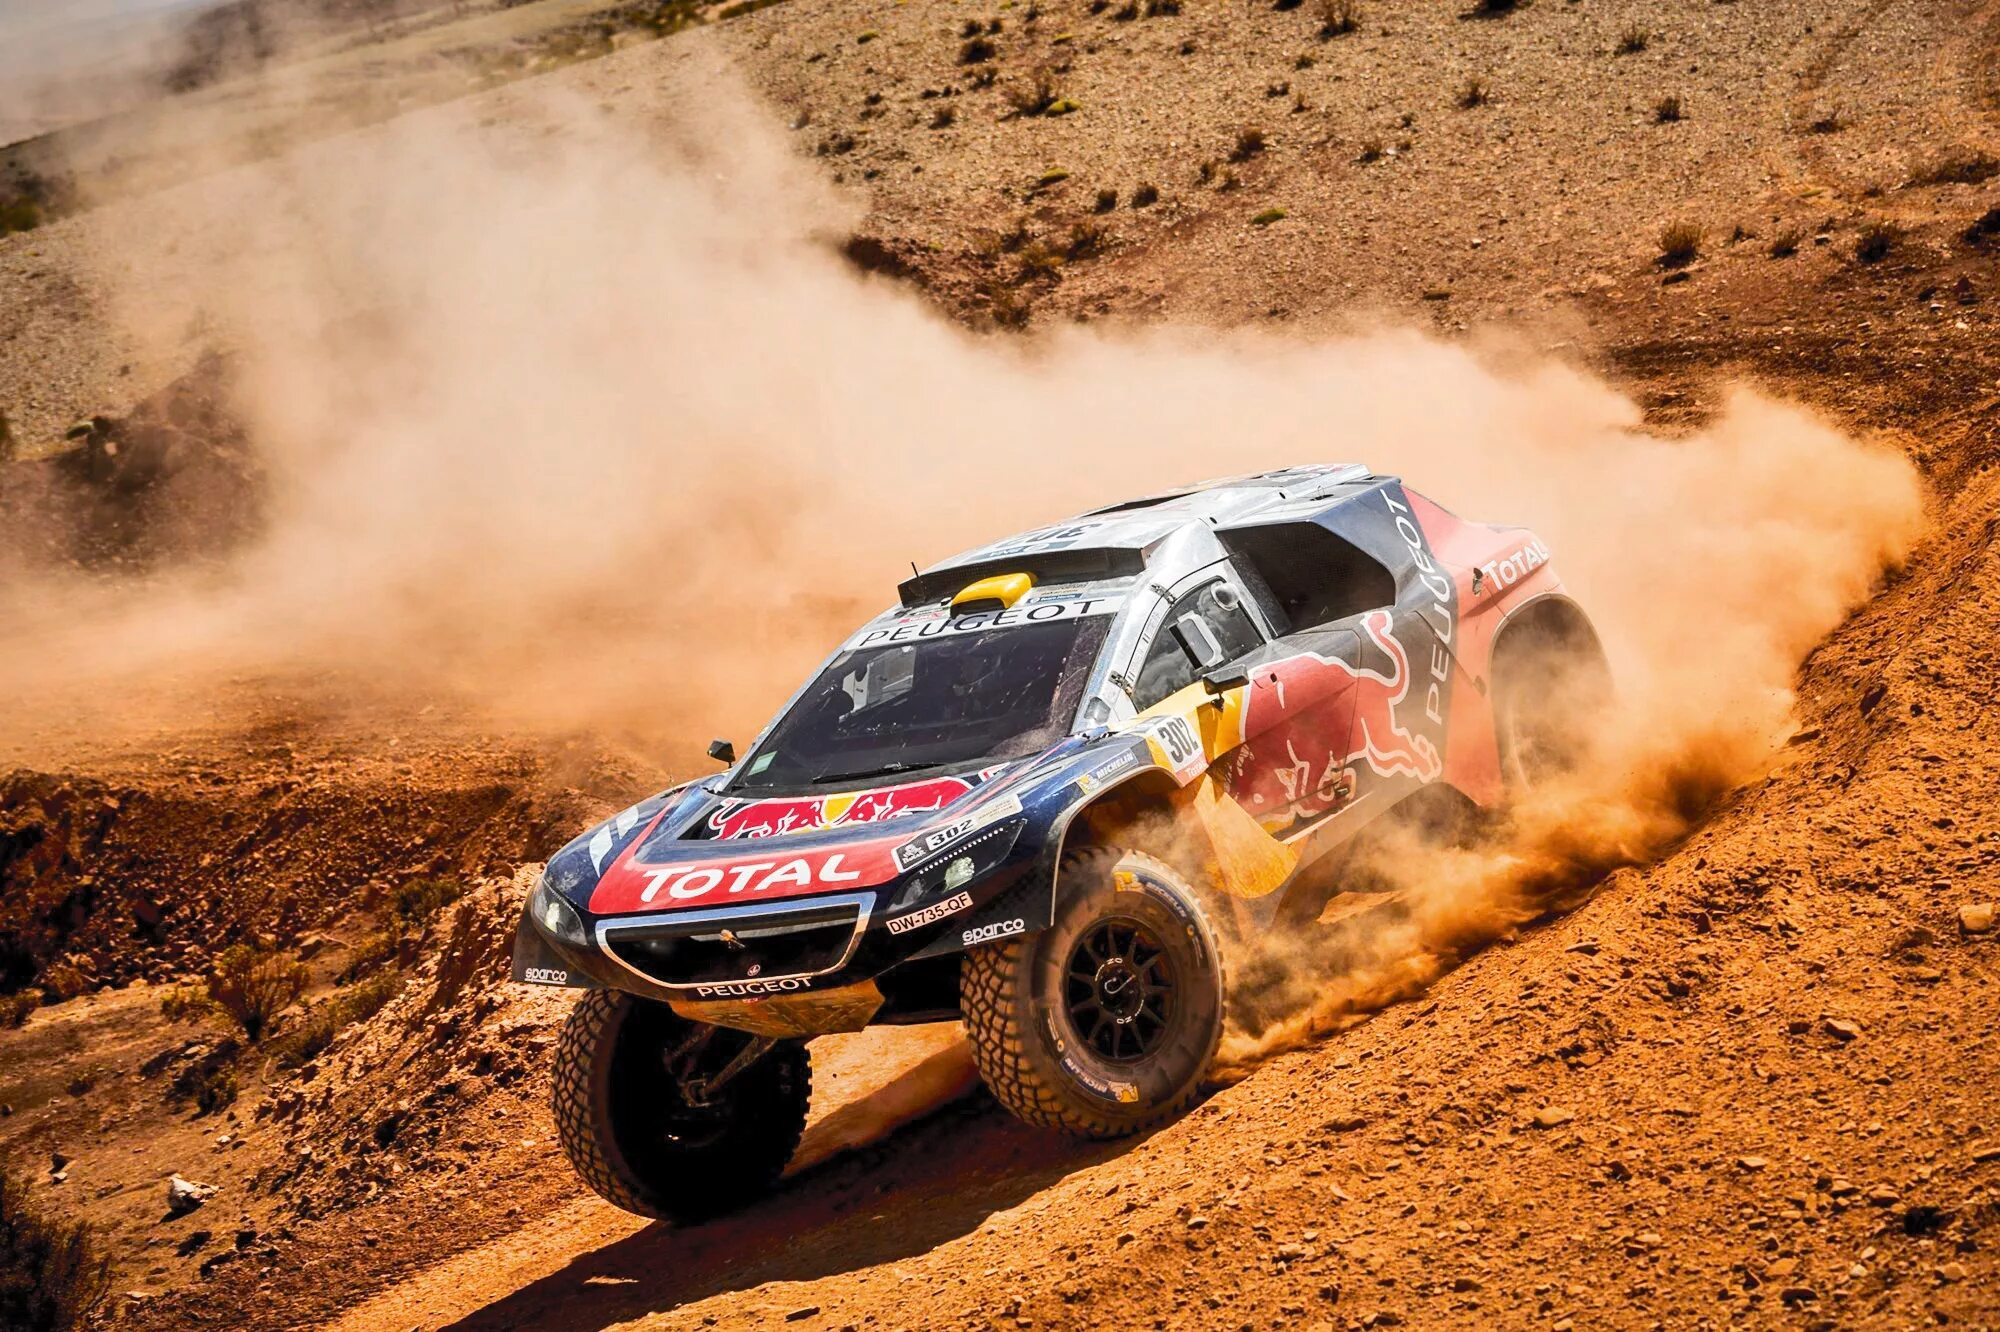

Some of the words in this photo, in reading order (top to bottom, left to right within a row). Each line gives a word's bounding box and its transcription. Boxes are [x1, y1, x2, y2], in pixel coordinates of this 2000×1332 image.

[1483, 540, 1551, 591] TOTAL
[858, 599, 1105, 647] PEUGEOT
[1379, 488, 1458, 727] PEUGEOT
[1157, 717, 1198, 763] 302
[1096, 751, 1135, 778] MICHELIN
[930, 819, 974, 846] 302
[640, 853, 862, 903] TOTAL
[890, 894, 970, 935] DW-735-QF
[962, 917, 1025, 942] sparco
[524, 967, 568, 982] sparco
[696, 976, 813, 998] PEUGEOT
